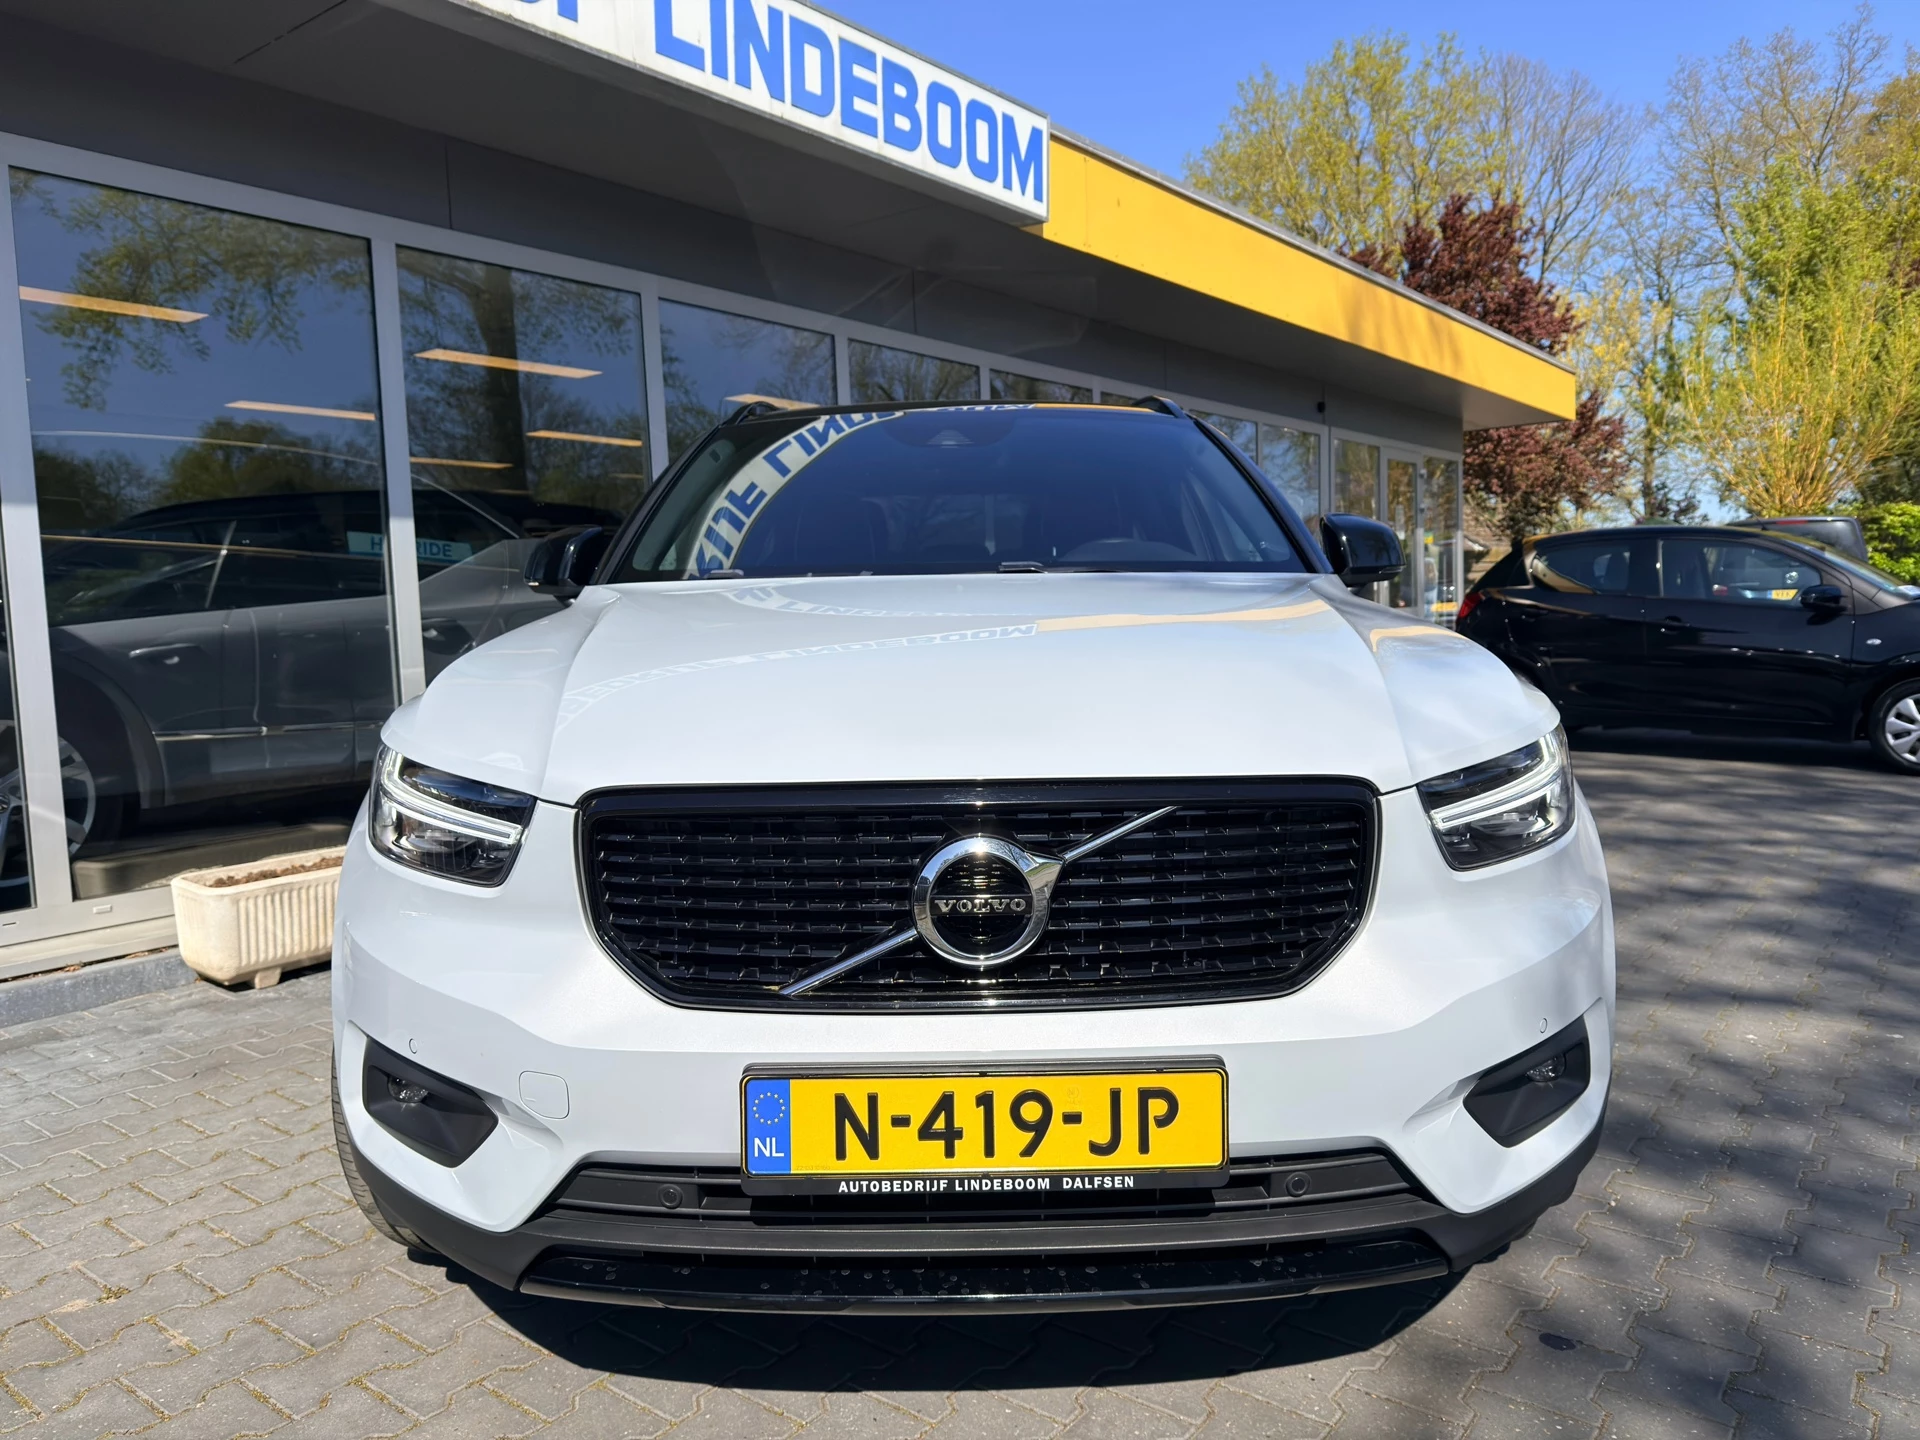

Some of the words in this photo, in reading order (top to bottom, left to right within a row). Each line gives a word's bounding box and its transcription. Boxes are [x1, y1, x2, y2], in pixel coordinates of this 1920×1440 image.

[654, 0, 1044, 204] LINDEBOOM
[934, 898, 1027, 913] VOLVO
[834, 1087, 1180, 1161] N-419-JP
[754, 1137, 785, 1157] NL
[838, 1179, 949, 1193] AUTOBEDRIJF
[955, 1177, 1051, 1191] LINDEBOOM
[1062, 1175, 1135, 1189] DALFSEN
